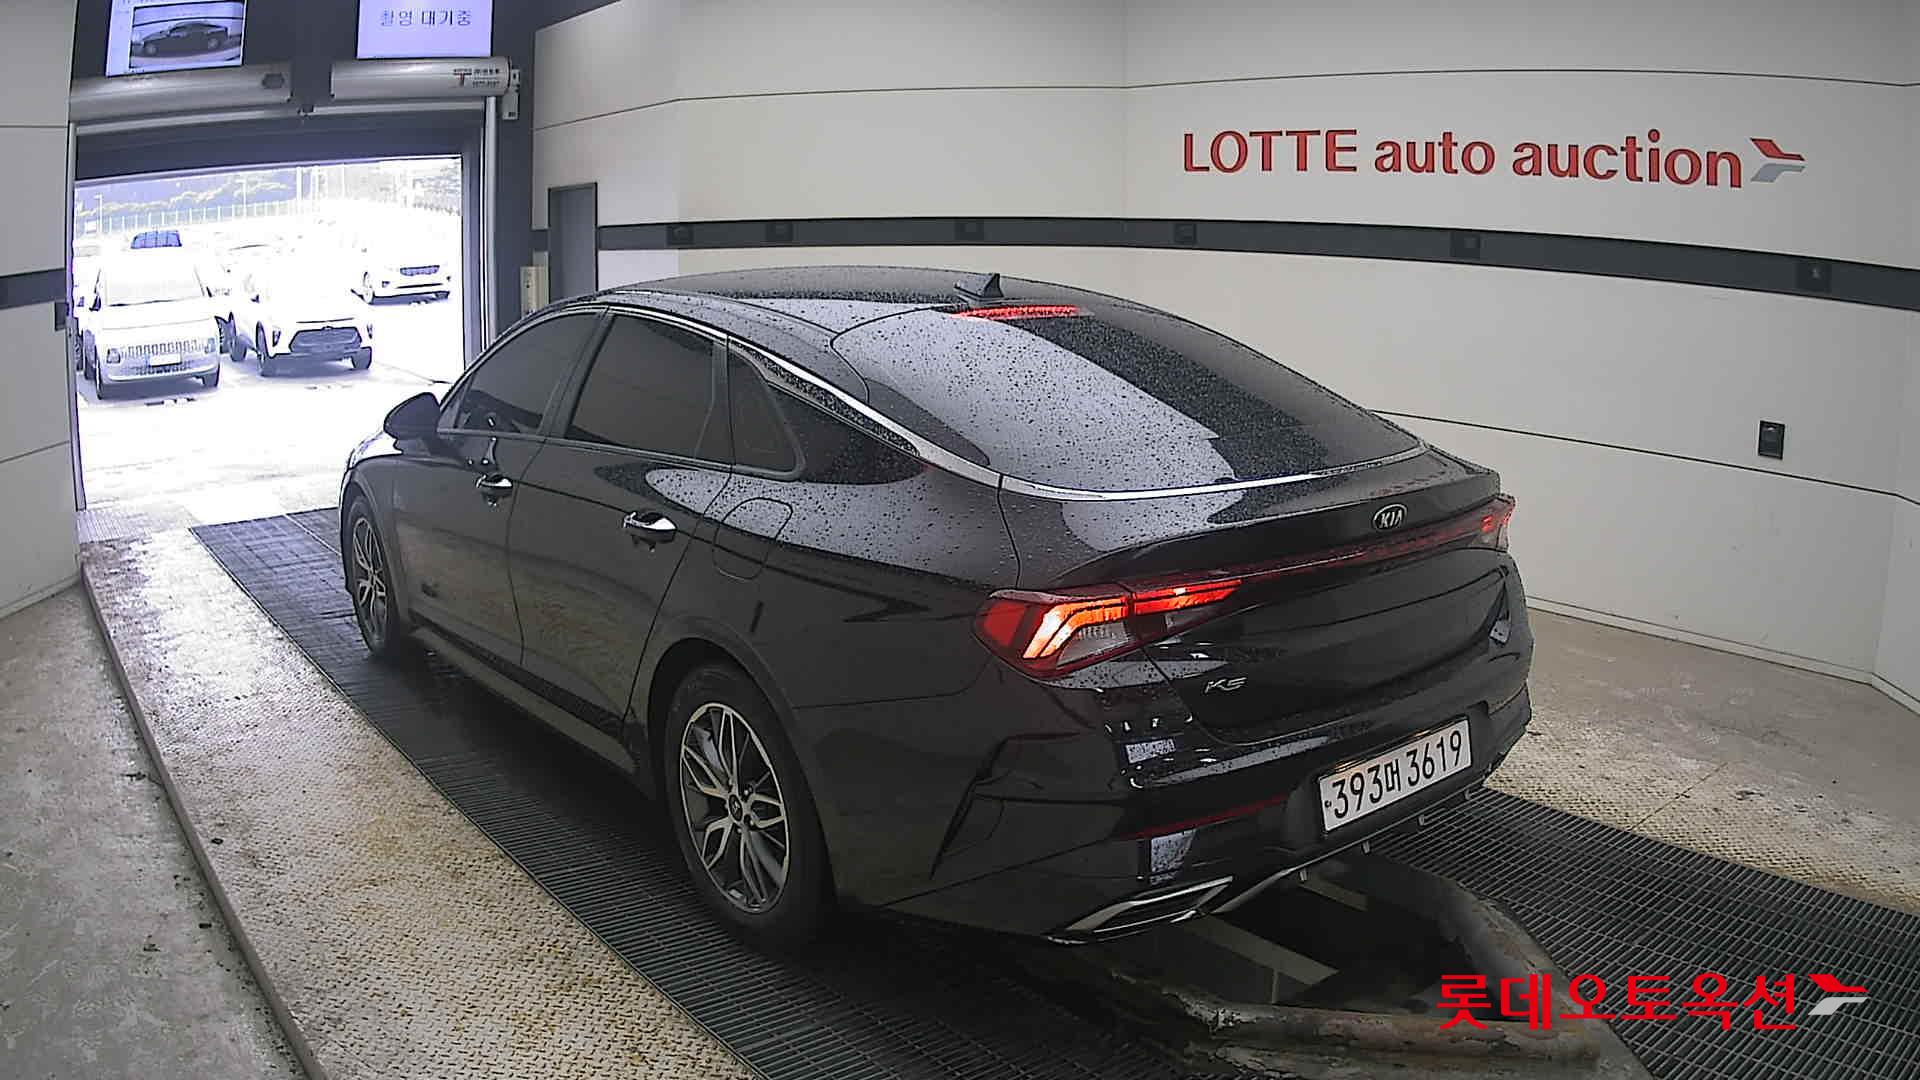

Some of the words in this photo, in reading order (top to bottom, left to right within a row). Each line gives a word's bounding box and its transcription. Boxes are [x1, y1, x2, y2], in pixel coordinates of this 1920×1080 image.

[1183, 129, 1357, 174] LOTTE
[1374, 131, 1496, 175] auto
[1512, 128, 1742, 188] auction
[1378, 508, 1403, 529] KIA
[1332, 758, 1401, 819] 393머
[1406, 730, 1462, 787] 3619
